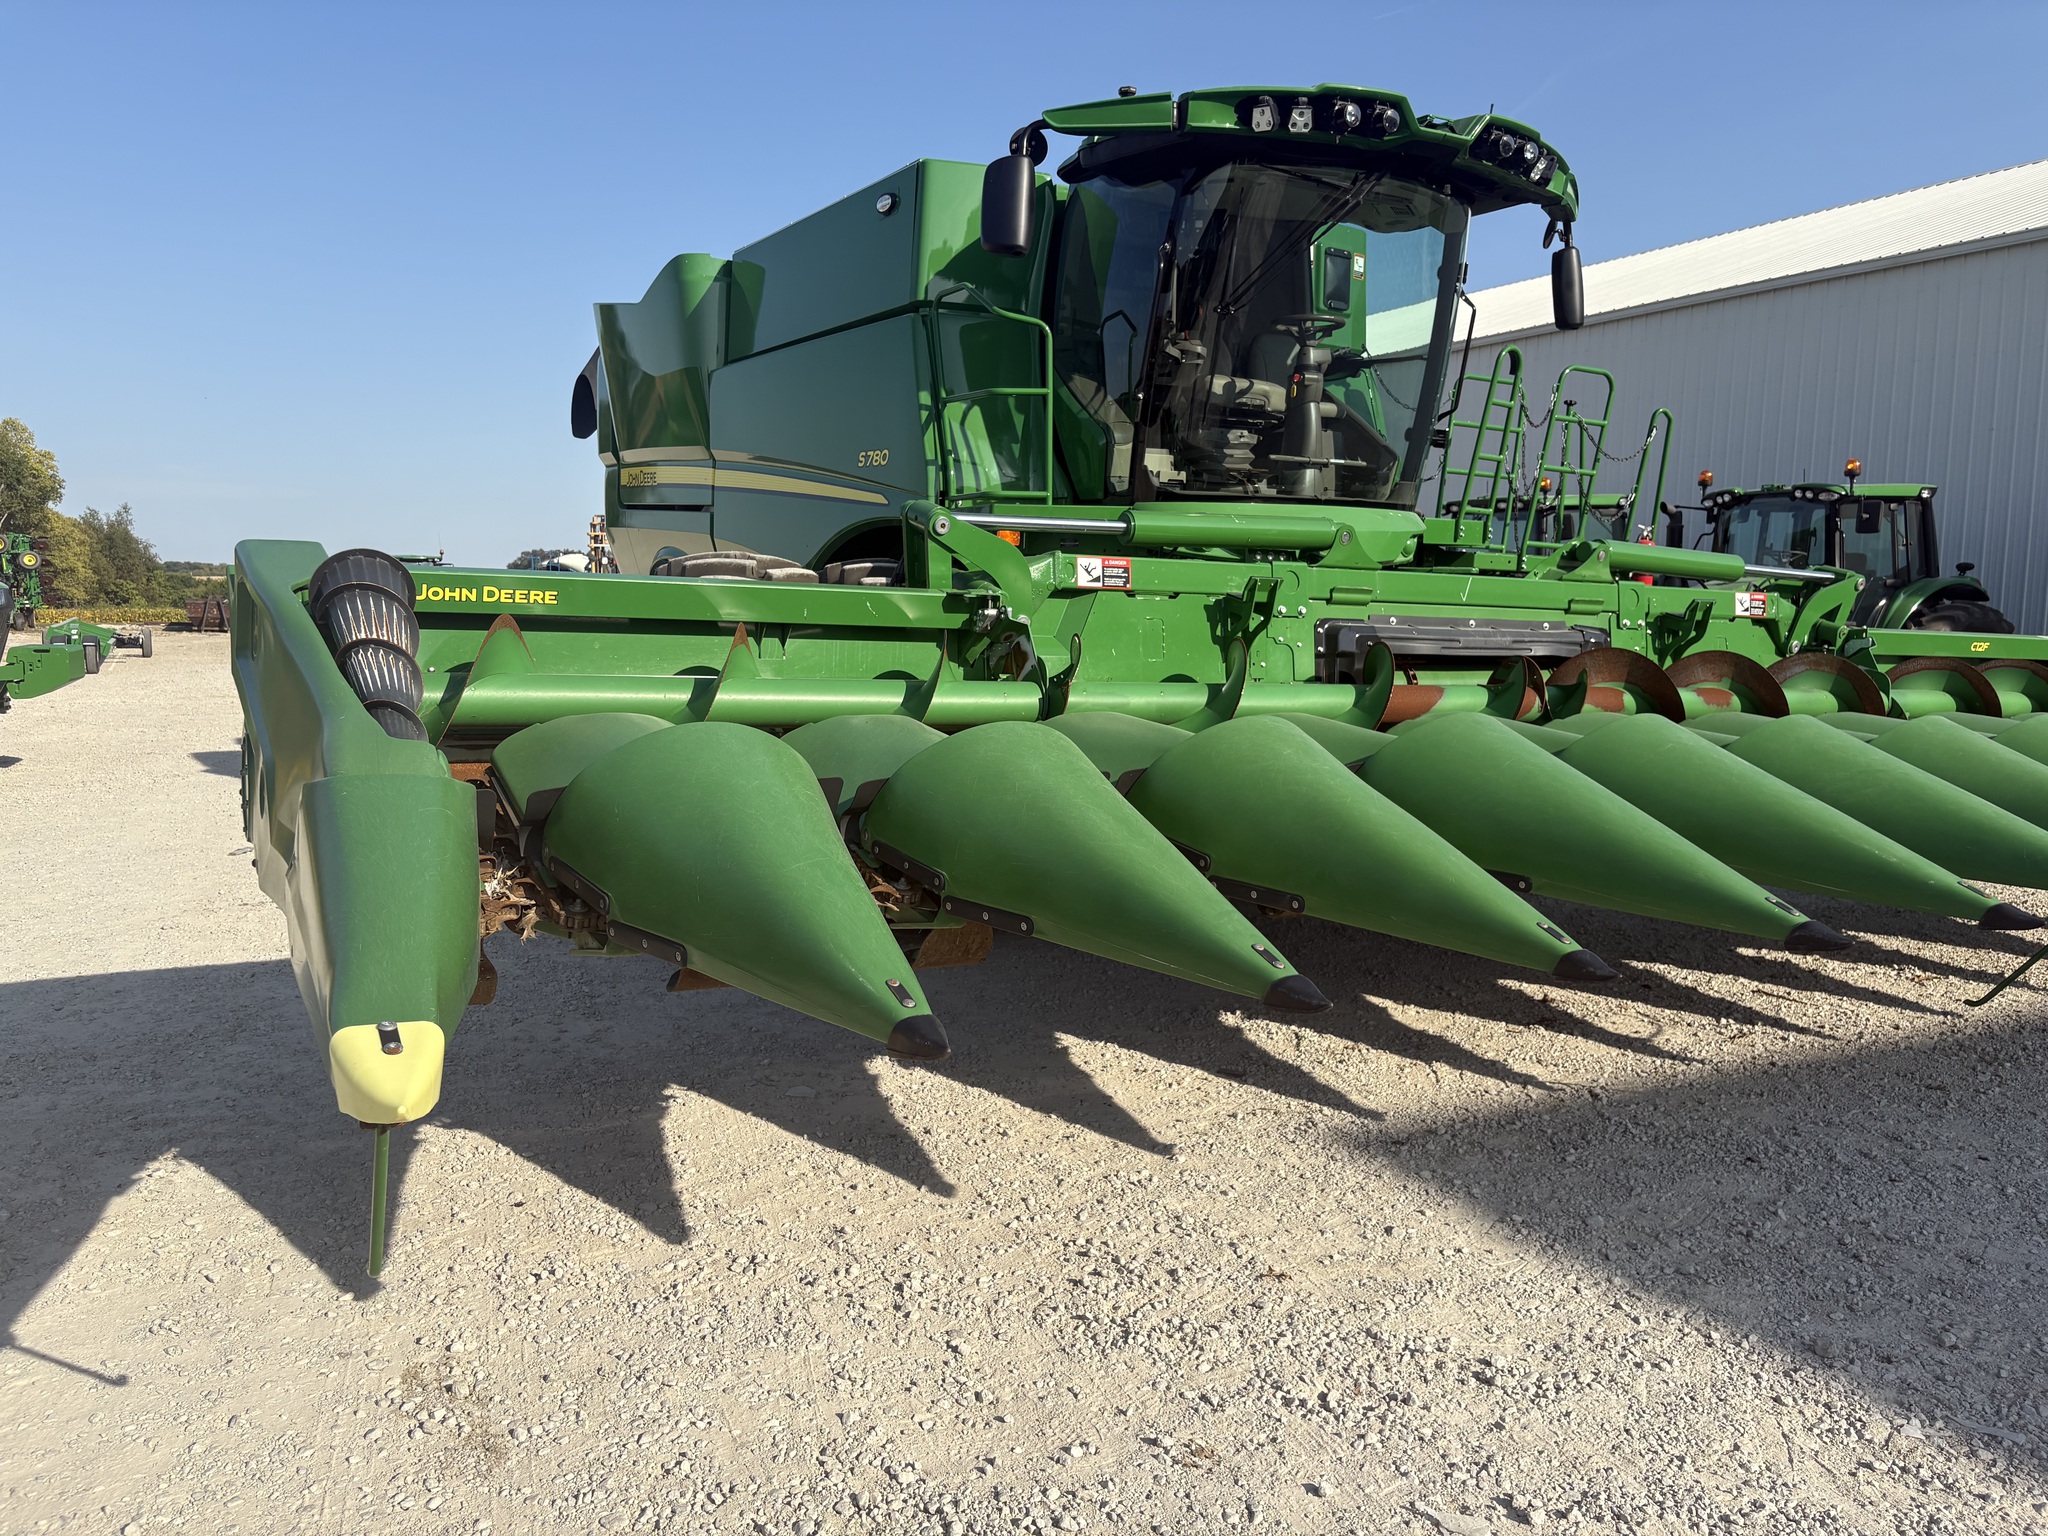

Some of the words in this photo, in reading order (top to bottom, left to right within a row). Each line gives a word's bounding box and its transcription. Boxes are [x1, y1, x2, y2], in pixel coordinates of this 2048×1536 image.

[858, 449, 889, 467] S780
[626, 471, 640, 486] JOHN
[640, 470, 657, 485] DEERE
[416, 584, 477, 602] JOHN
[482, 586, 558, 605] DEERE
[1970, 641, 1990, 652] C12F
